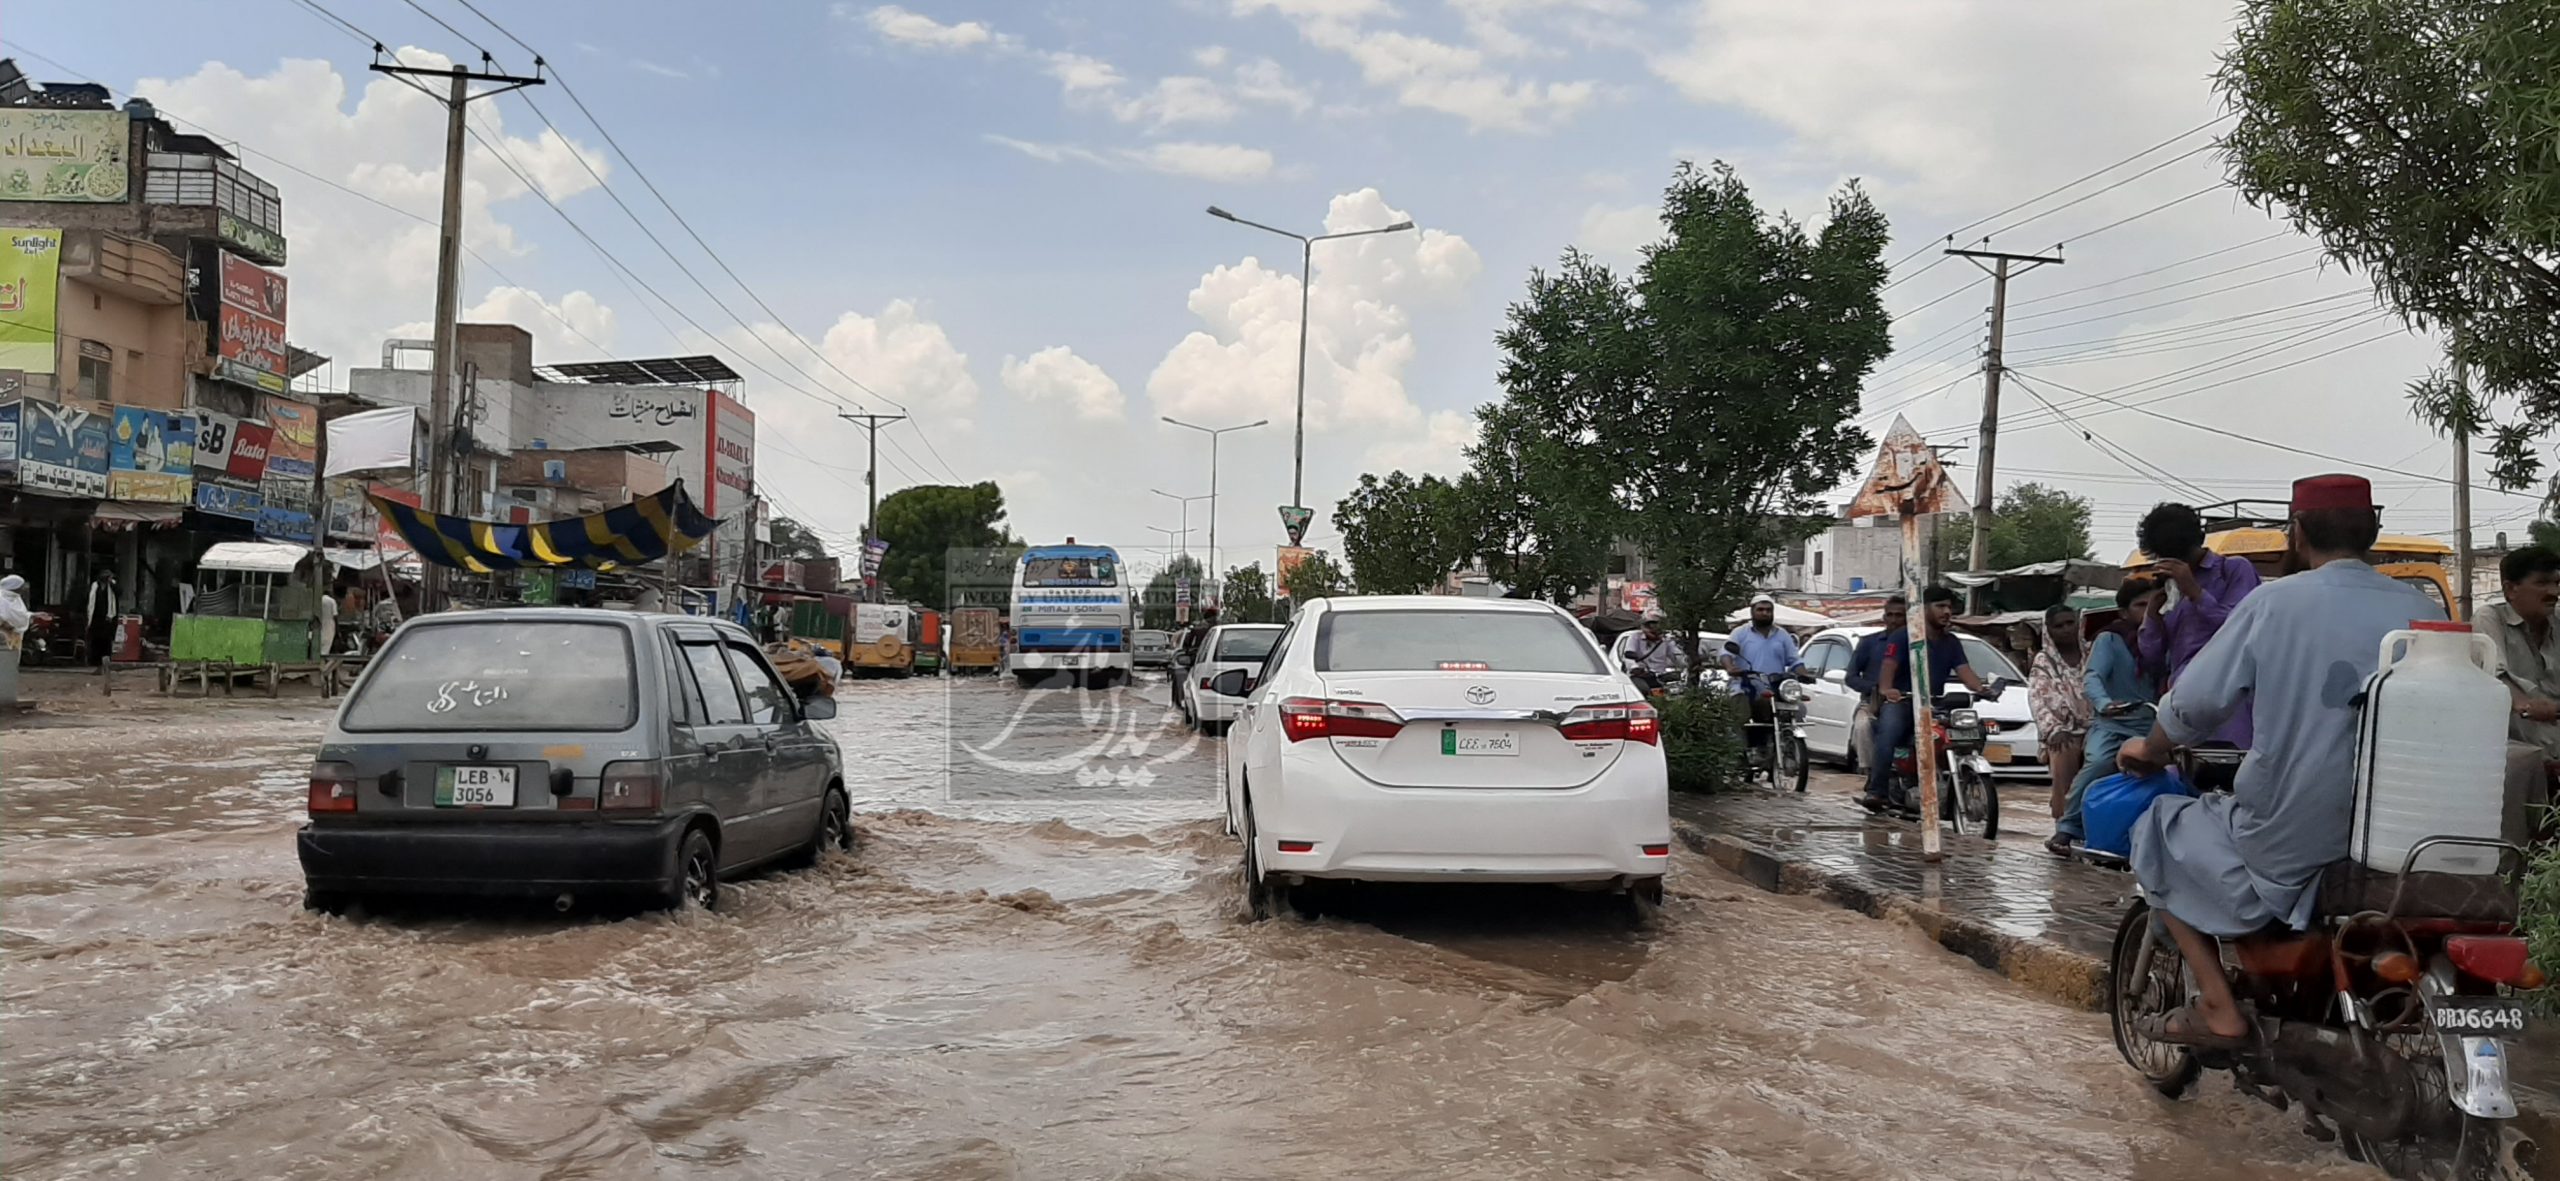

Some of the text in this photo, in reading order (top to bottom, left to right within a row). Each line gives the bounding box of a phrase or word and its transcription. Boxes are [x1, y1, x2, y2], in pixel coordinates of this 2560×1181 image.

[11, 236, 57, 250] Sunlight
[233, 438, 266, 461] Bata
[1074, 605, 1103, 613] SONS
[1459, 738, 1480, 750] LEE
[458, 770, 489, 785] LEB
[456, 787, 494, 802] 3056
